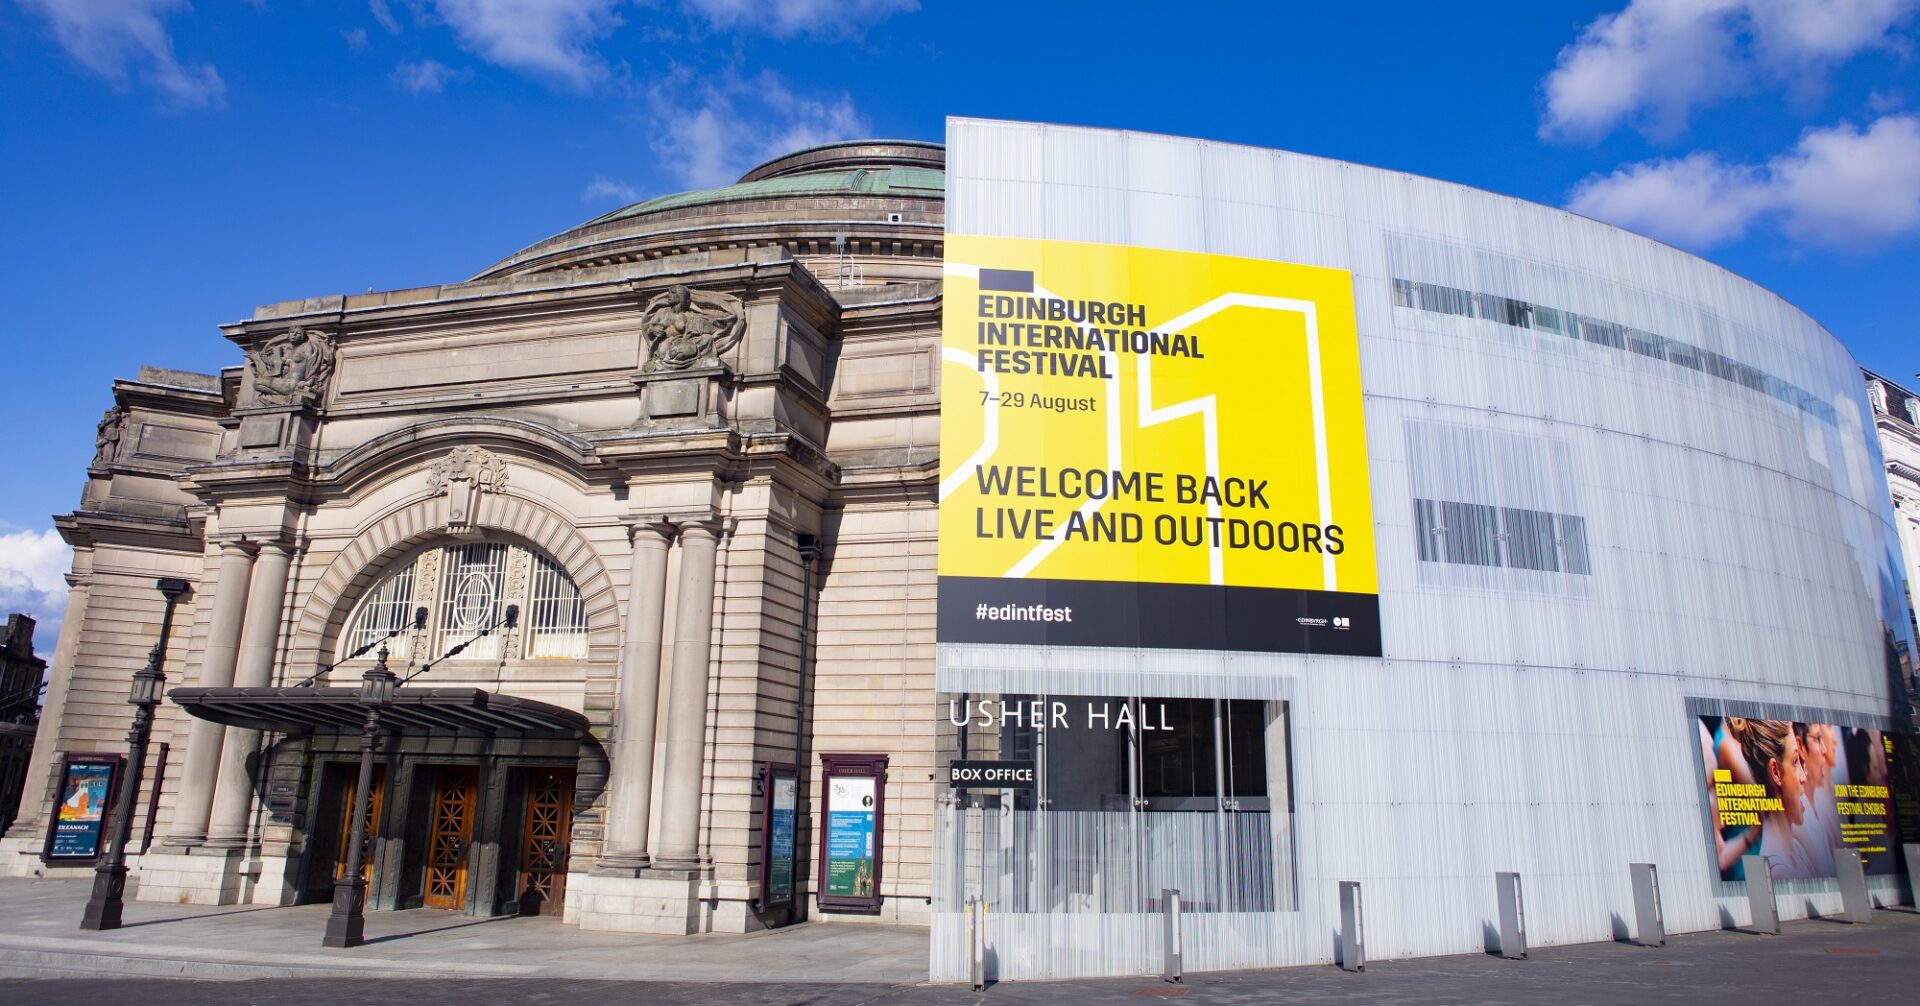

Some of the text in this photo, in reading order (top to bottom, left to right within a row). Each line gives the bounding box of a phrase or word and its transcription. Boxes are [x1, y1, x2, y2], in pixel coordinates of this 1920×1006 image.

[978, 294, 1146, 328] EDINBURGH
[978, 321, 1204, 359] INTERNATIONAL
[977, 349, 1113, 379] FESTIVAL
[1030, 393, 1097, 413] August
[976, 464, 1270, 510] WELCOME BACK
[976, 507, 1345, 556] LIVE AND OUTDOORS
[975, 603, 1073, 623] #edintfest
[949, 699, 1175, 731] USHER HALL
[951, 768, 1033, 782] BOX OFFICE
[1715, 784, 1766, 797] EDINBURGH
[1859, 785, 1889, 798] EDINBURGH
[1717, 798, 1785, 811] INTERNATIONAL
[1836, 802, 1865, 815] FESTIVAL
[1863, 803, 1887, 815] CHORUS
[1720, 812, 1761, 826] FESTIVAL
